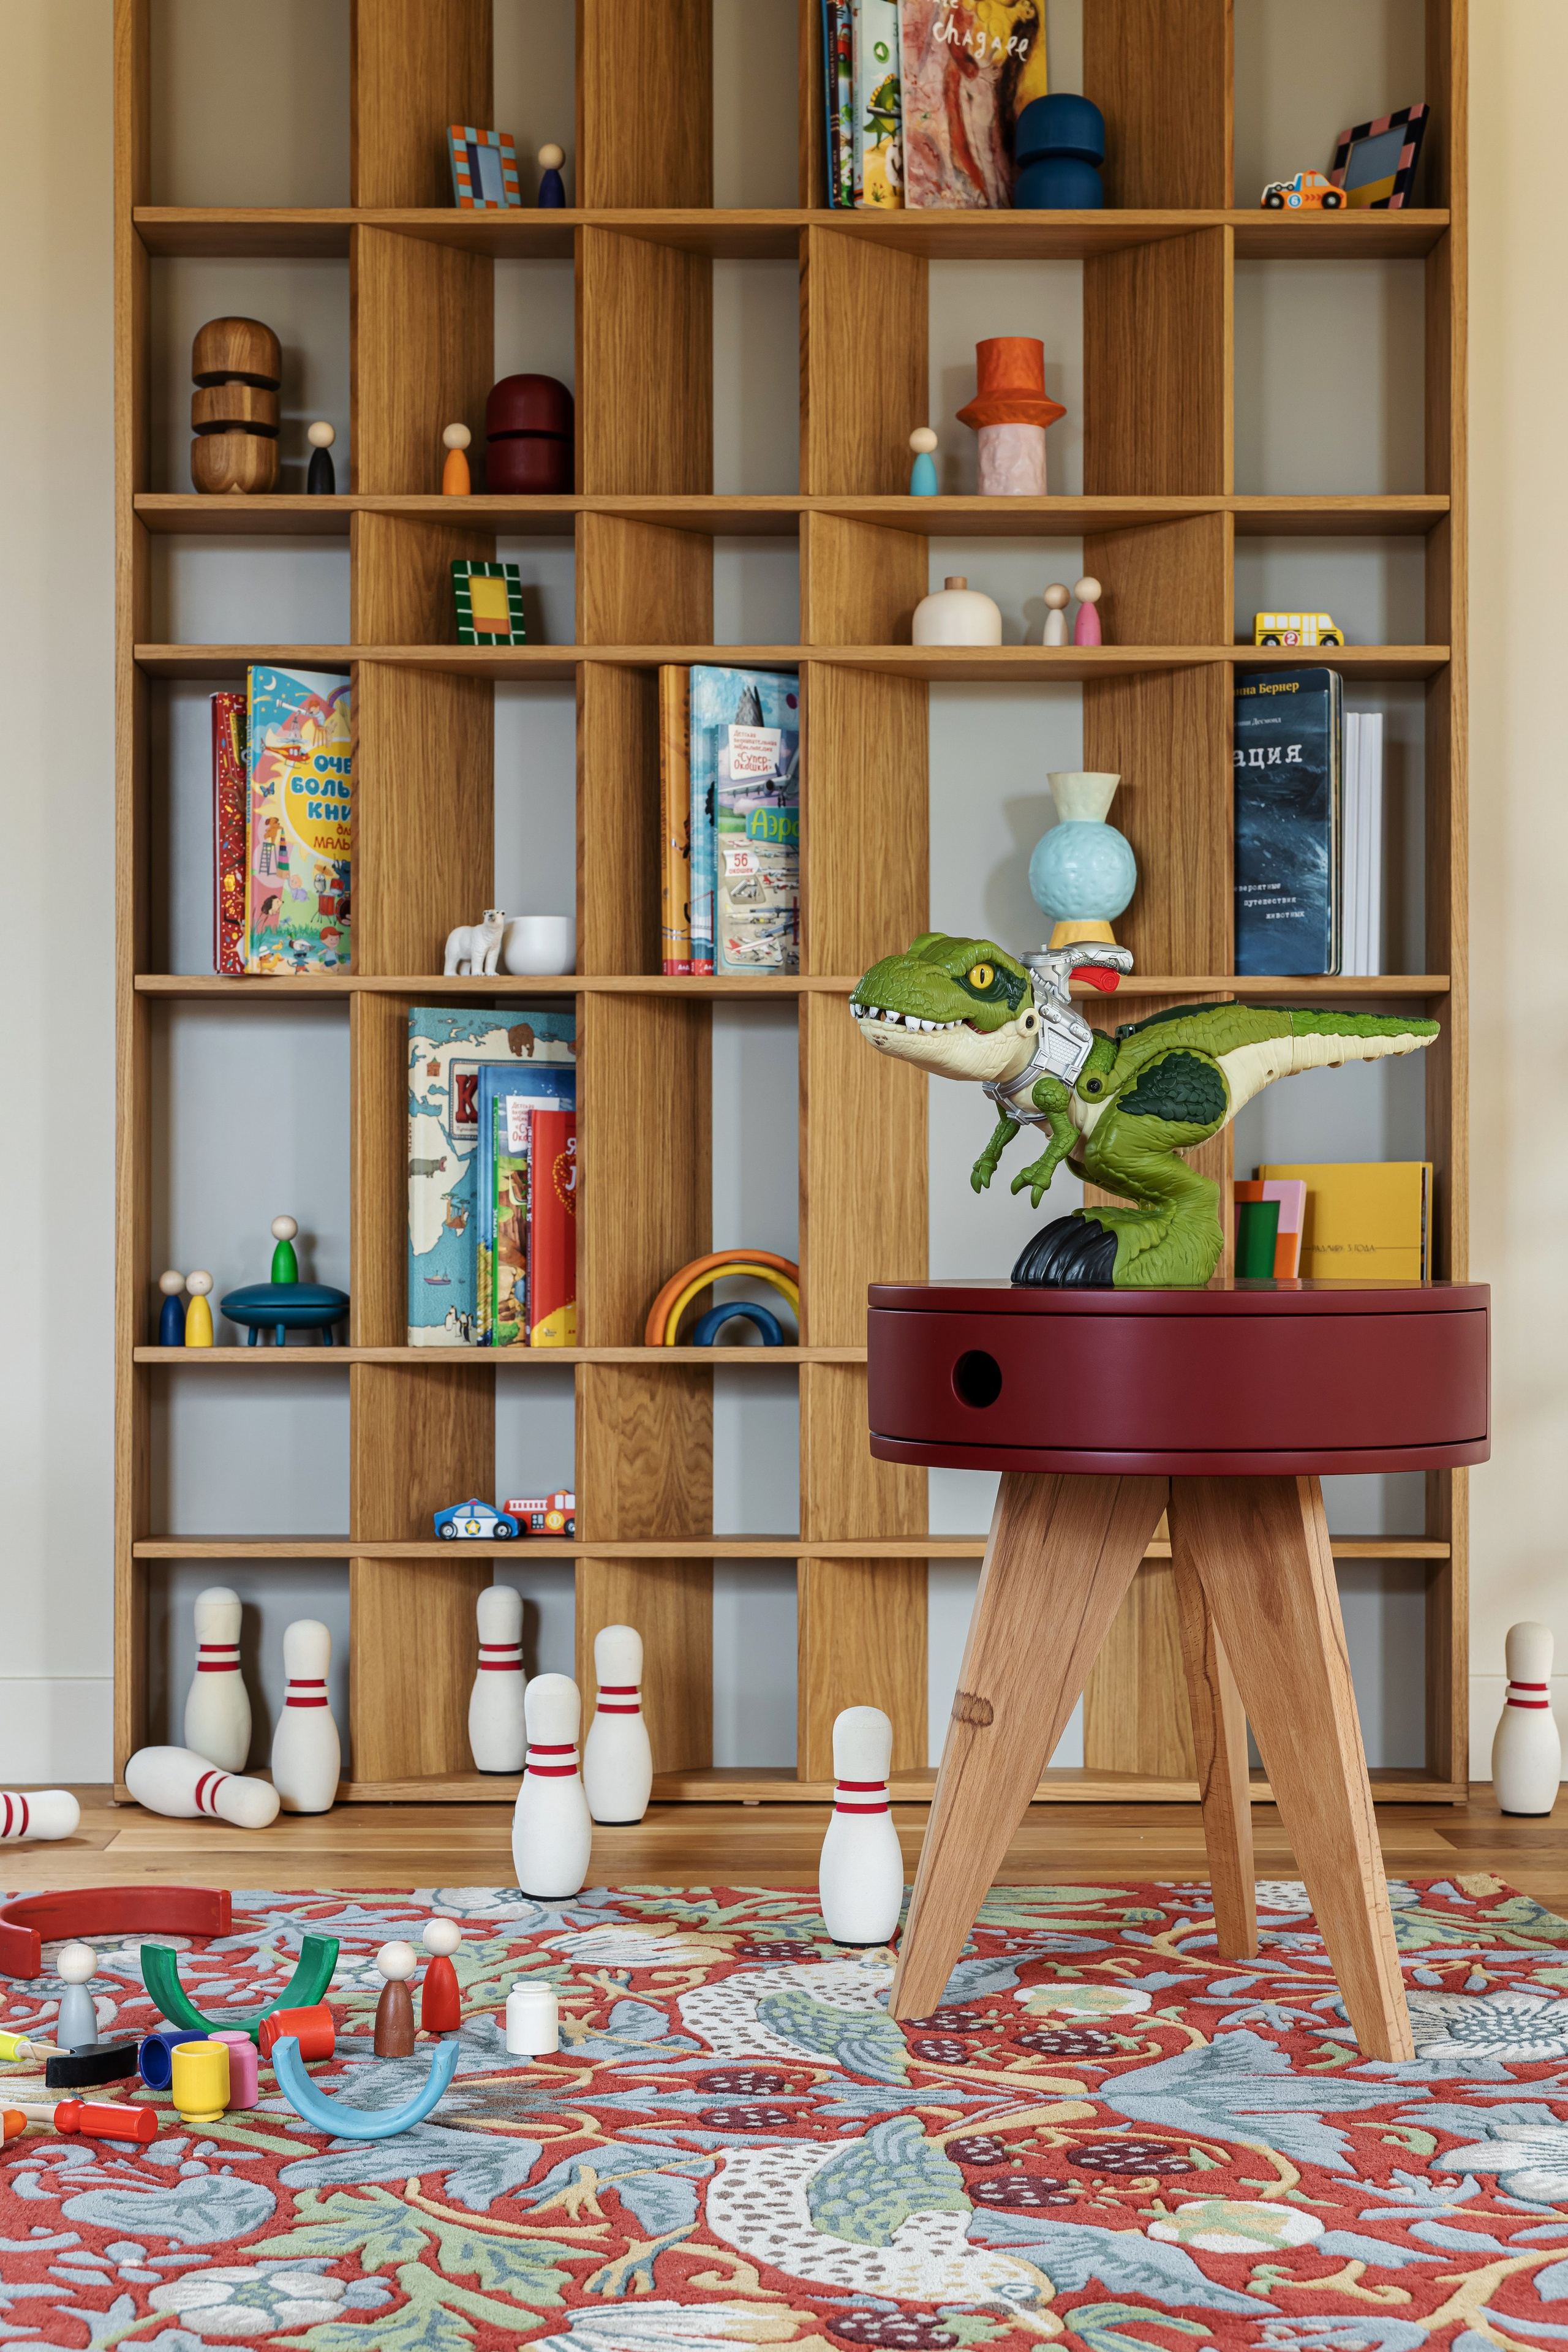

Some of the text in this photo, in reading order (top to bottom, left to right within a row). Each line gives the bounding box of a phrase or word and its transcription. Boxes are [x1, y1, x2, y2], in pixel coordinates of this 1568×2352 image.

[1286, 633, 1296, 644] 2
[1259, 682, 1300, 696] Бернер
[291, 777, 351, 799] БОЛЬ
[734, 853, 748, 867] 56
